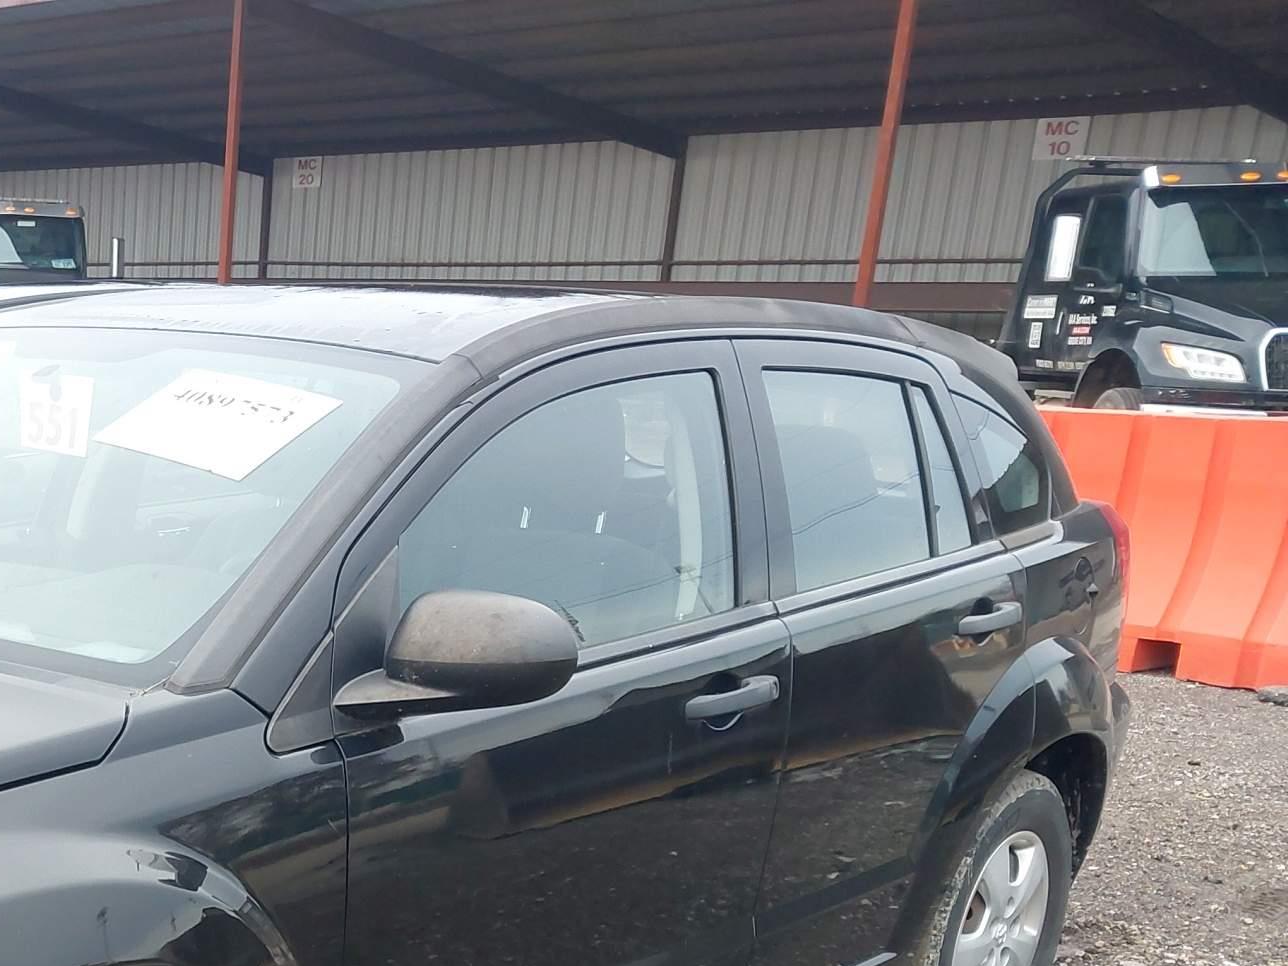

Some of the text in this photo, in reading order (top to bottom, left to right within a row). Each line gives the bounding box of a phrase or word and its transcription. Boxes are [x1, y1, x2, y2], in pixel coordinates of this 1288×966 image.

[1045, 120, 1080, 136] MC
[1048, 141, 1071, 156] 10
[297, 159, 317, 170] MC
[299, 174, 314, 185] 20
[27, 400, 80, 449] 551
